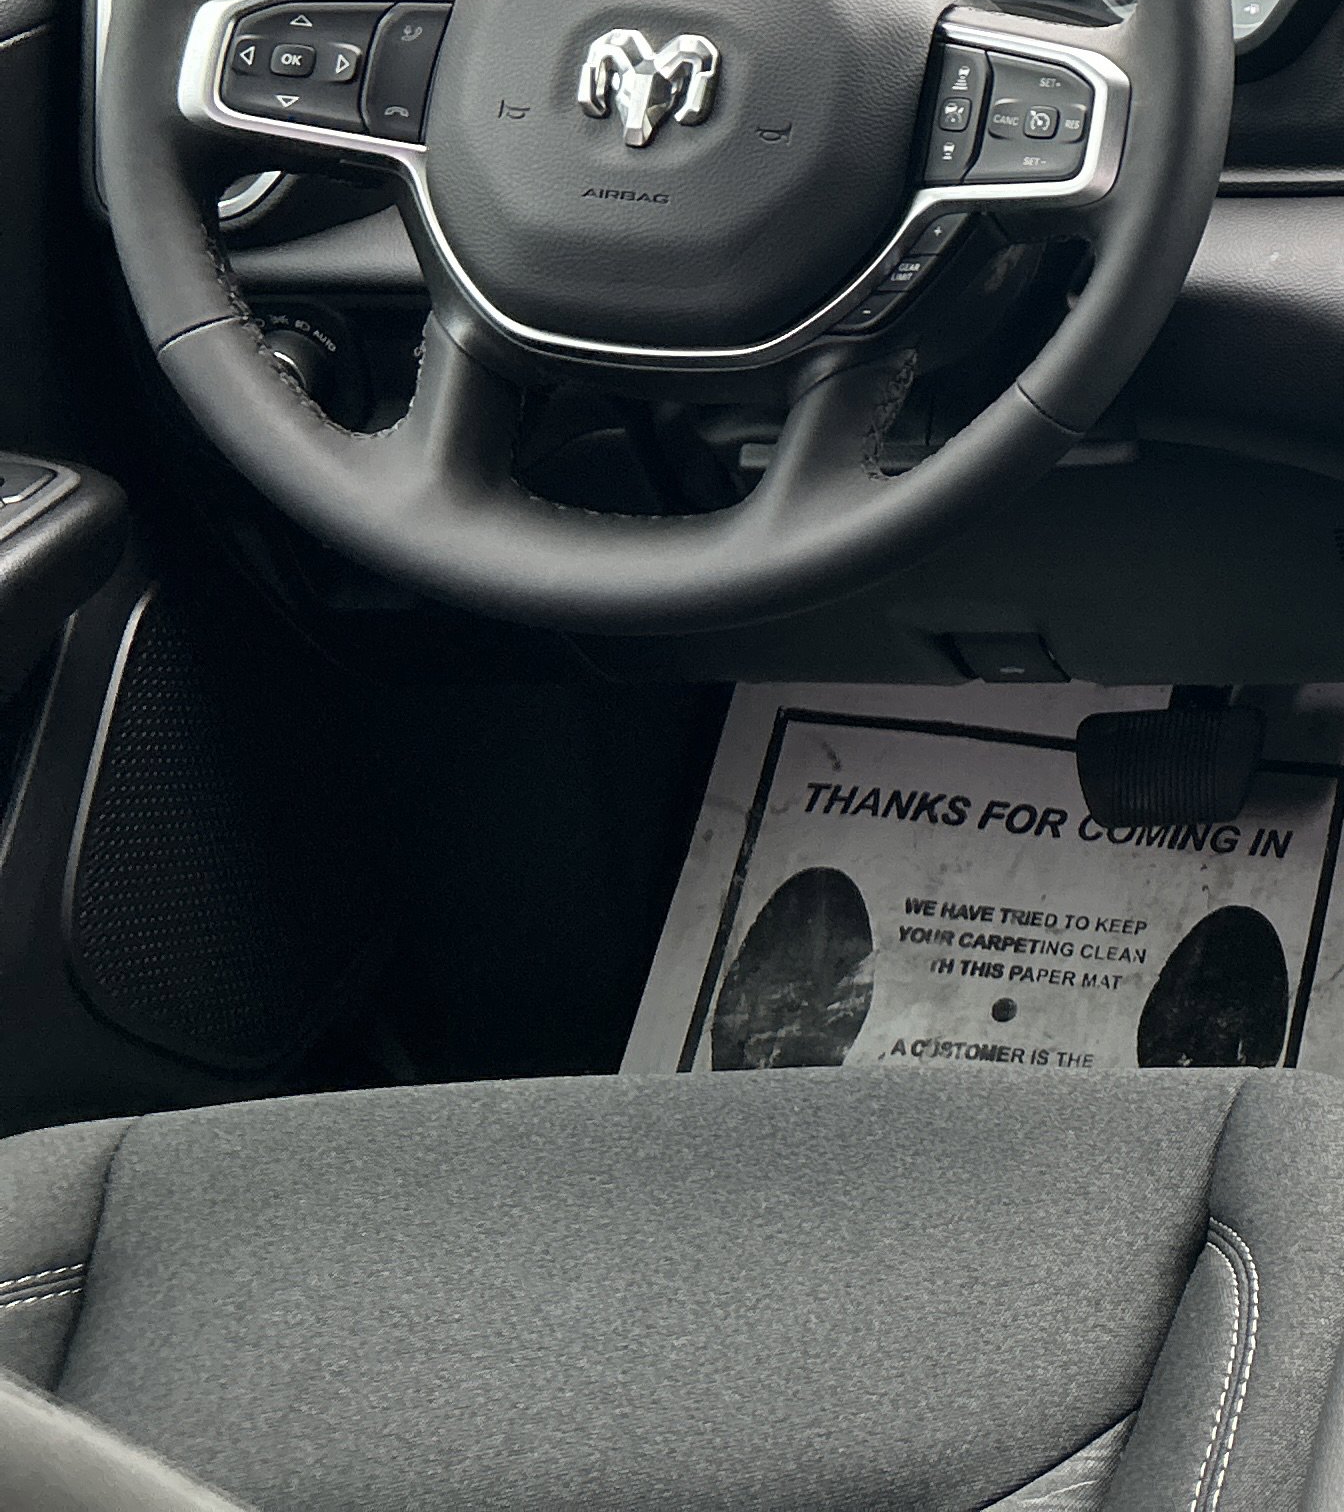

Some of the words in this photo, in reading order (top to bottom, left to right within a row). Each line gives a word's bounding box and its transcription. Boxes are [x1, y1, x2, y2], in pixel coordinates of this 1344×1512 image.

[281, 53, 303, 66] OK
[993, 113, 1020, 127] CANC
[581, 188, 670, 205] AIRBAG
[313, 330, 337, 352] AUTO
[804, 781, 972, 826] THANKS
[977, 800, 1068, 839] FOR
[1248, 828, 1293, 859] IN
[905, 897, 938, 917] WE
[940, 901, 995, 923] HAVE
[999, 907, 1058, 929] TRIED
[1065, 913, 1090, 931] TO
[1094, 917, 1148, 936] KEEP
[898, 925, 955, 947] YOUR
[958, 931, 1075, 958] CARPETING
[1079, 943, 1147, 964] CLEAN
[960, 958, 1005, 980] THIS
[1008, 964, 1076, 987] PAPER
[1081, 973, 1124, 990] MAT
[890, 1038, 907, 1057] A
[1030, 1049, 1050, 1066] IS
[1056, 1051, 1095, 1069] THE
